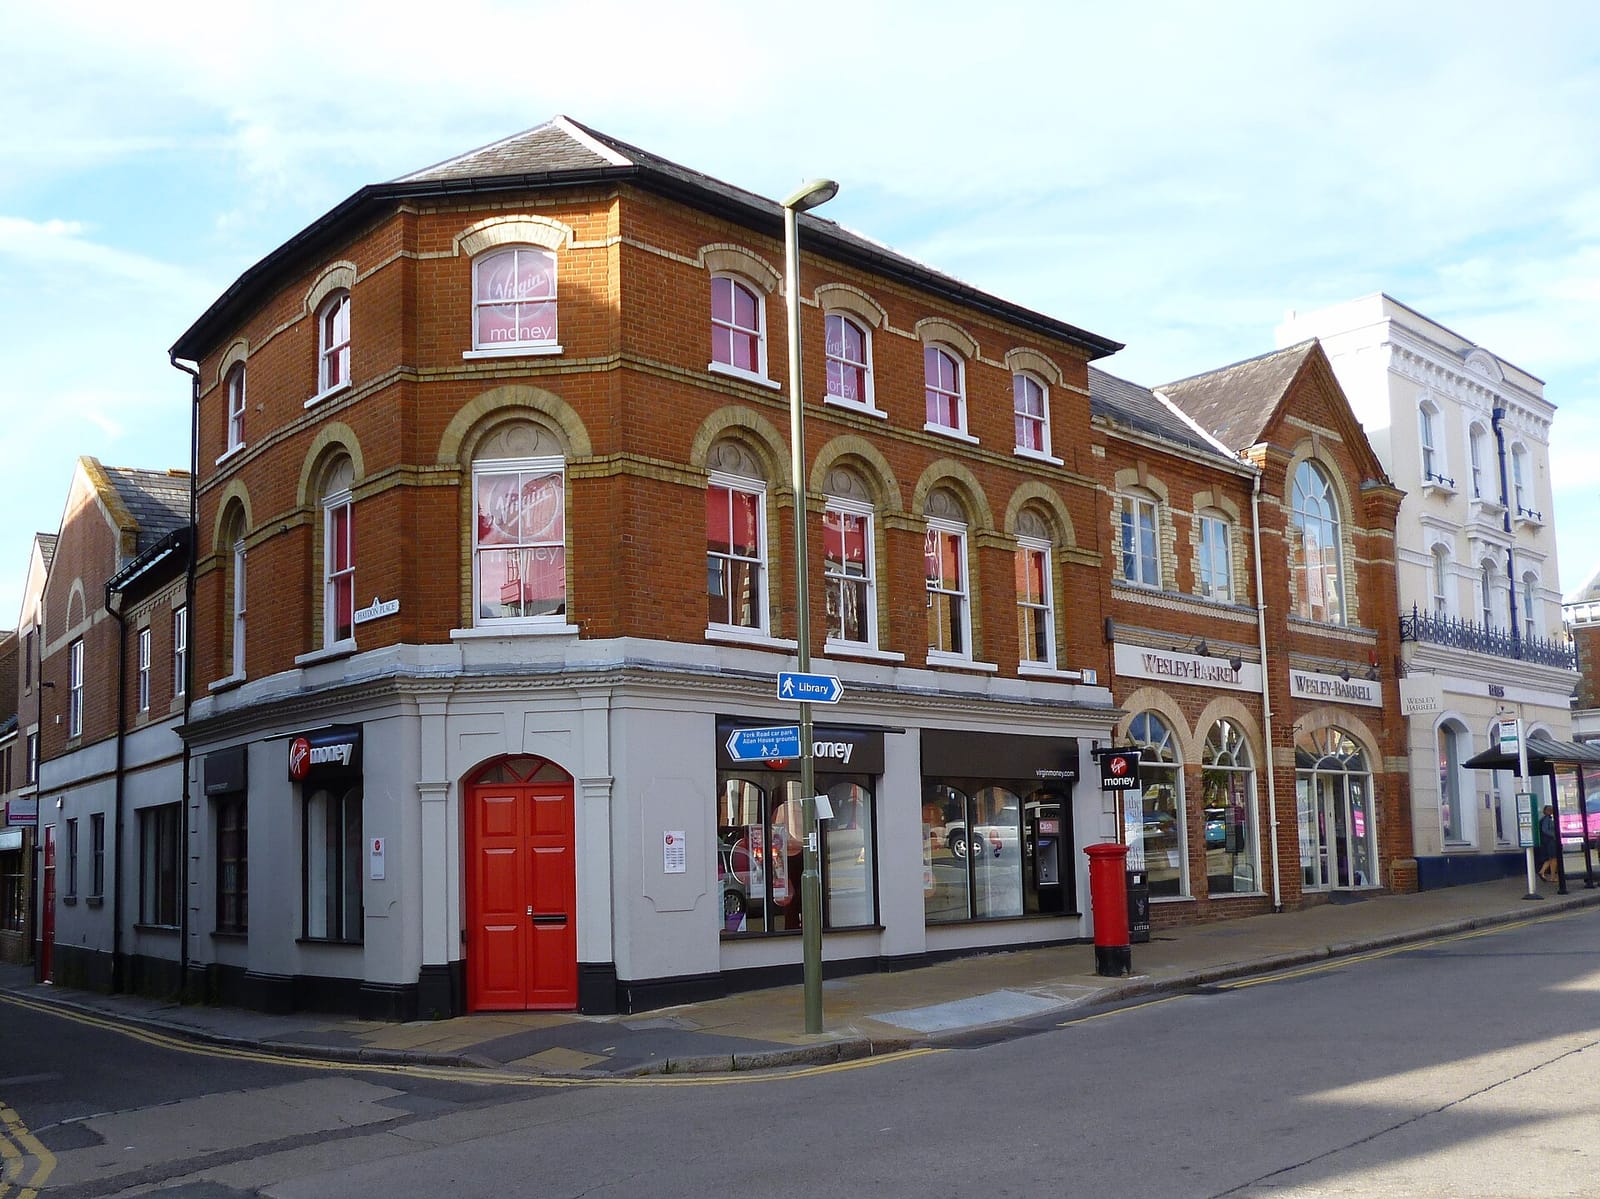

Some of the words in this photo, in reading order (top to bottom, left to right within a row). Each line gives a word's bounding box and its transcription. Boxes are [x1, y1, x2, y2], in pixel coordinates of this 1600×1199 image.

[1142, 653, 1243, 684] WESLEY-BARRELL
[798, 682, 829, 695] Library
[1295, 675, 1373, 701] WESLEY-BARRELL
[1407, 696, 1436, 705] WESLEY
[756, 730, 770, 738] Road
[780, 729, 793, 737] park
[775, 735, 798, 743] grounds
[309, 743, 353, 766] money
[811, 741, 854, 764] oney
[1035, 769, 1075, 778] virginmoney.com
[1103, 776, 1135, 788] money
